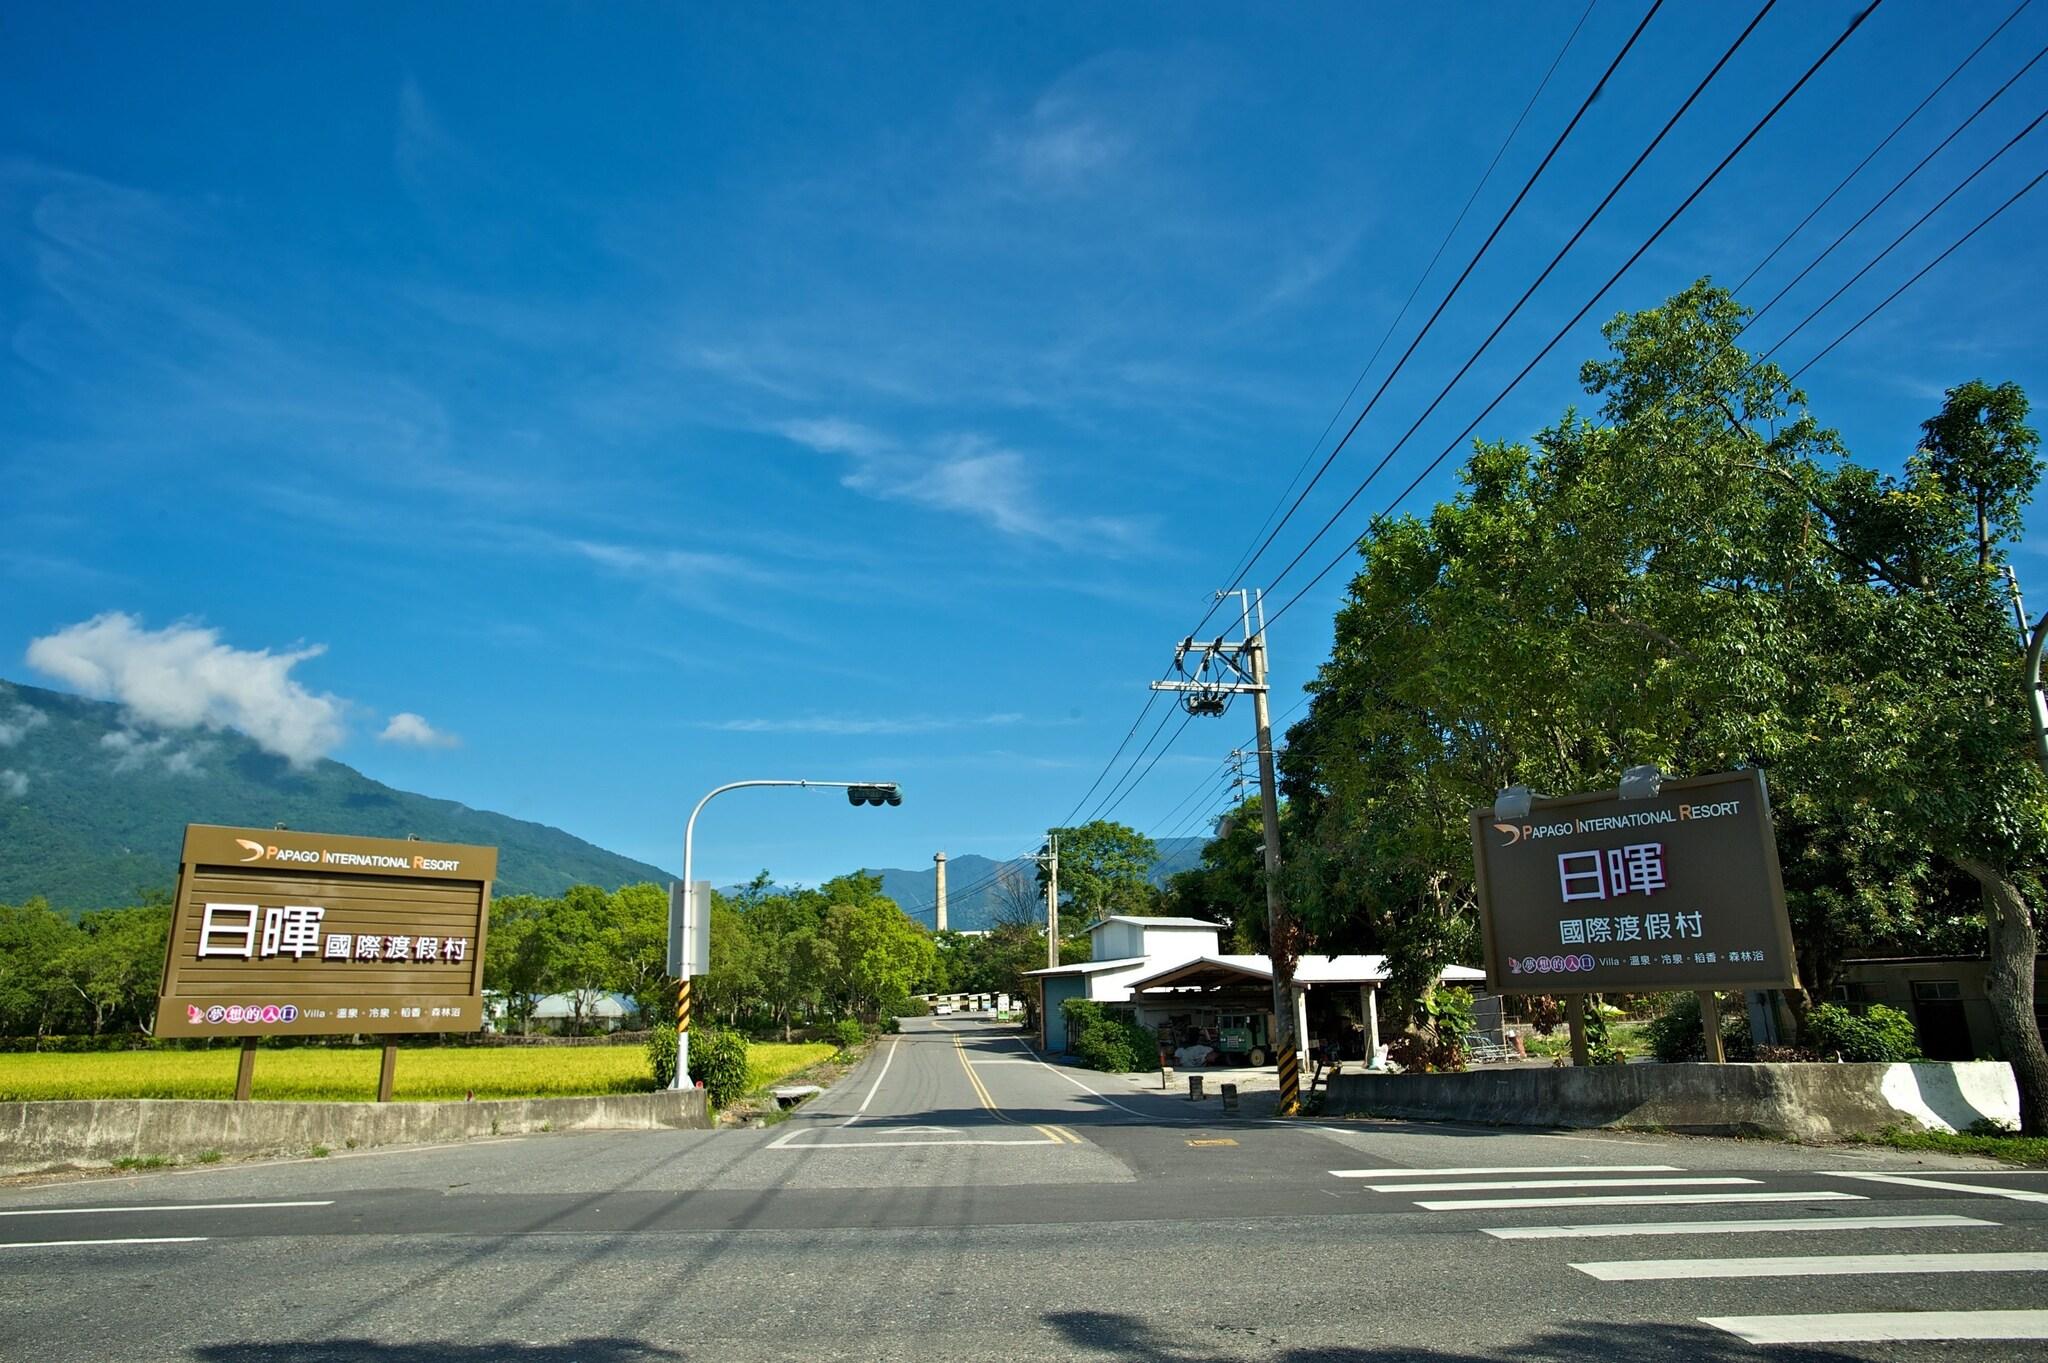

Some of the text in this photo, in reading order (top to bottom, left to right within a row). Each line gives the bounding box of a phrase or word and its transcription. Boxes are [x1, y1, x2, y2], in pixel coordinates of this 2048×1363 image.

[1523, 800, 1740, 841] PAPAGO INTERNATIONAL RESORT
[266, 845, 460, 872] PAPAGO INTERNATIONAL RESORT
[1557, 842, 1667, 904] 日暉
[1559, 910, 1704, 945] 國際渡假村
[1599, 955, 1620, 967] Villa
[303, 1008, 326, 1018] Villa
